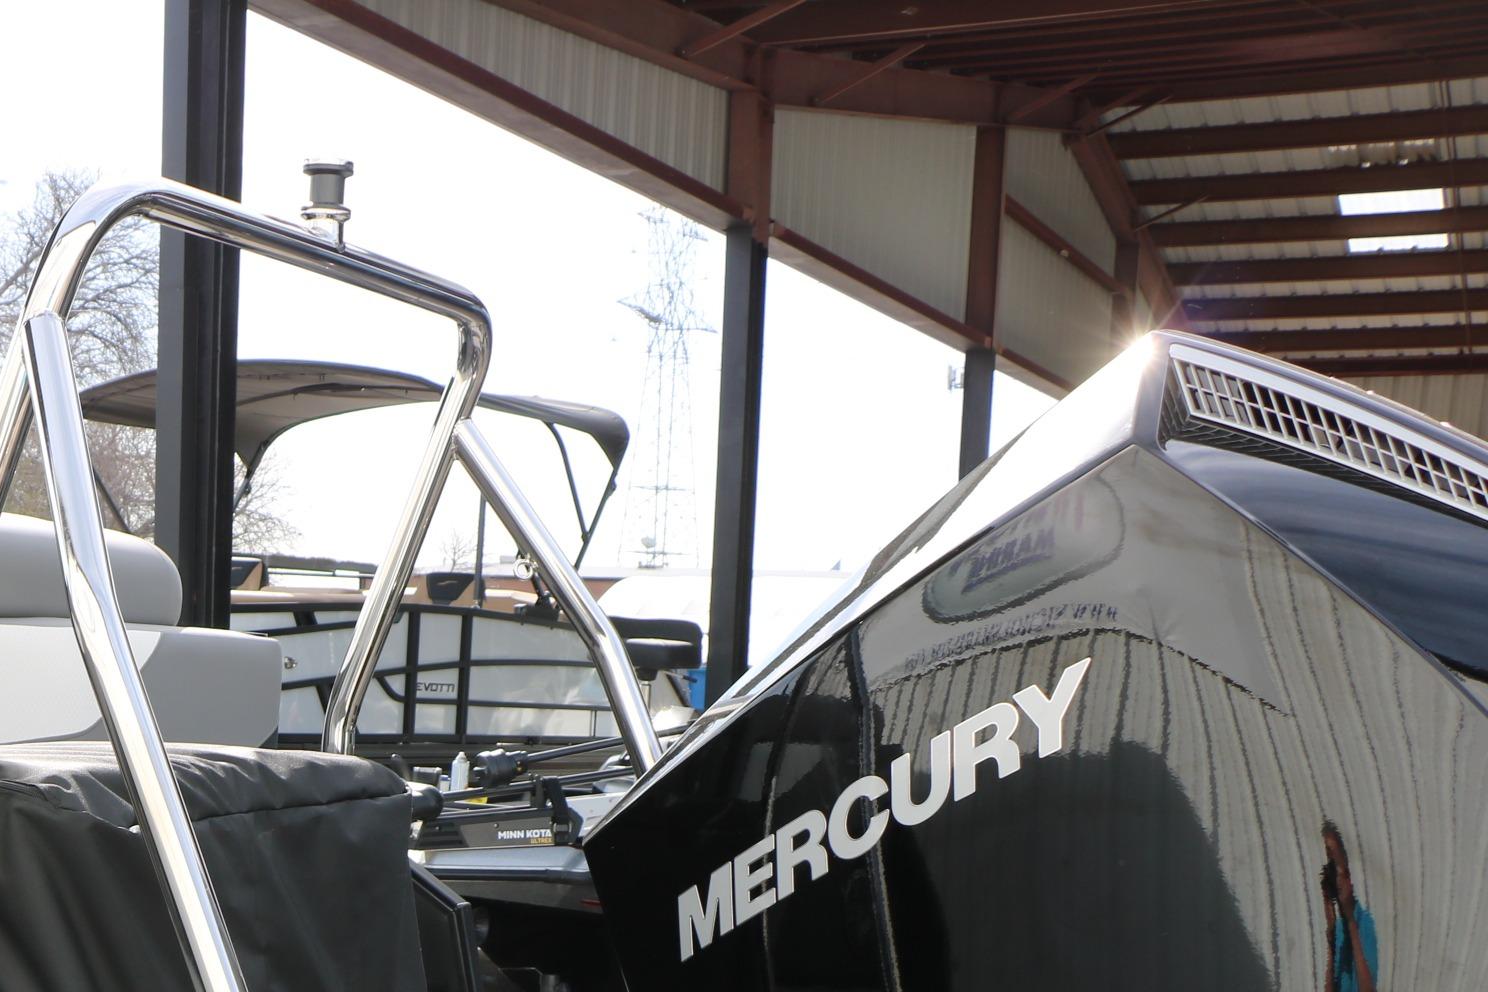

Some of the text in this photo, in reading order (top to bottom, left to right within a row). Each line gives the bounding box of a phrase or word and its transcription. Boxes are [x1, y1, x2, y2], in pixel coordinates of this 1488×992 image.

[497, 828, 552, 839] MINN KOTA
[677, 657, 1092, 962] MERCURY
